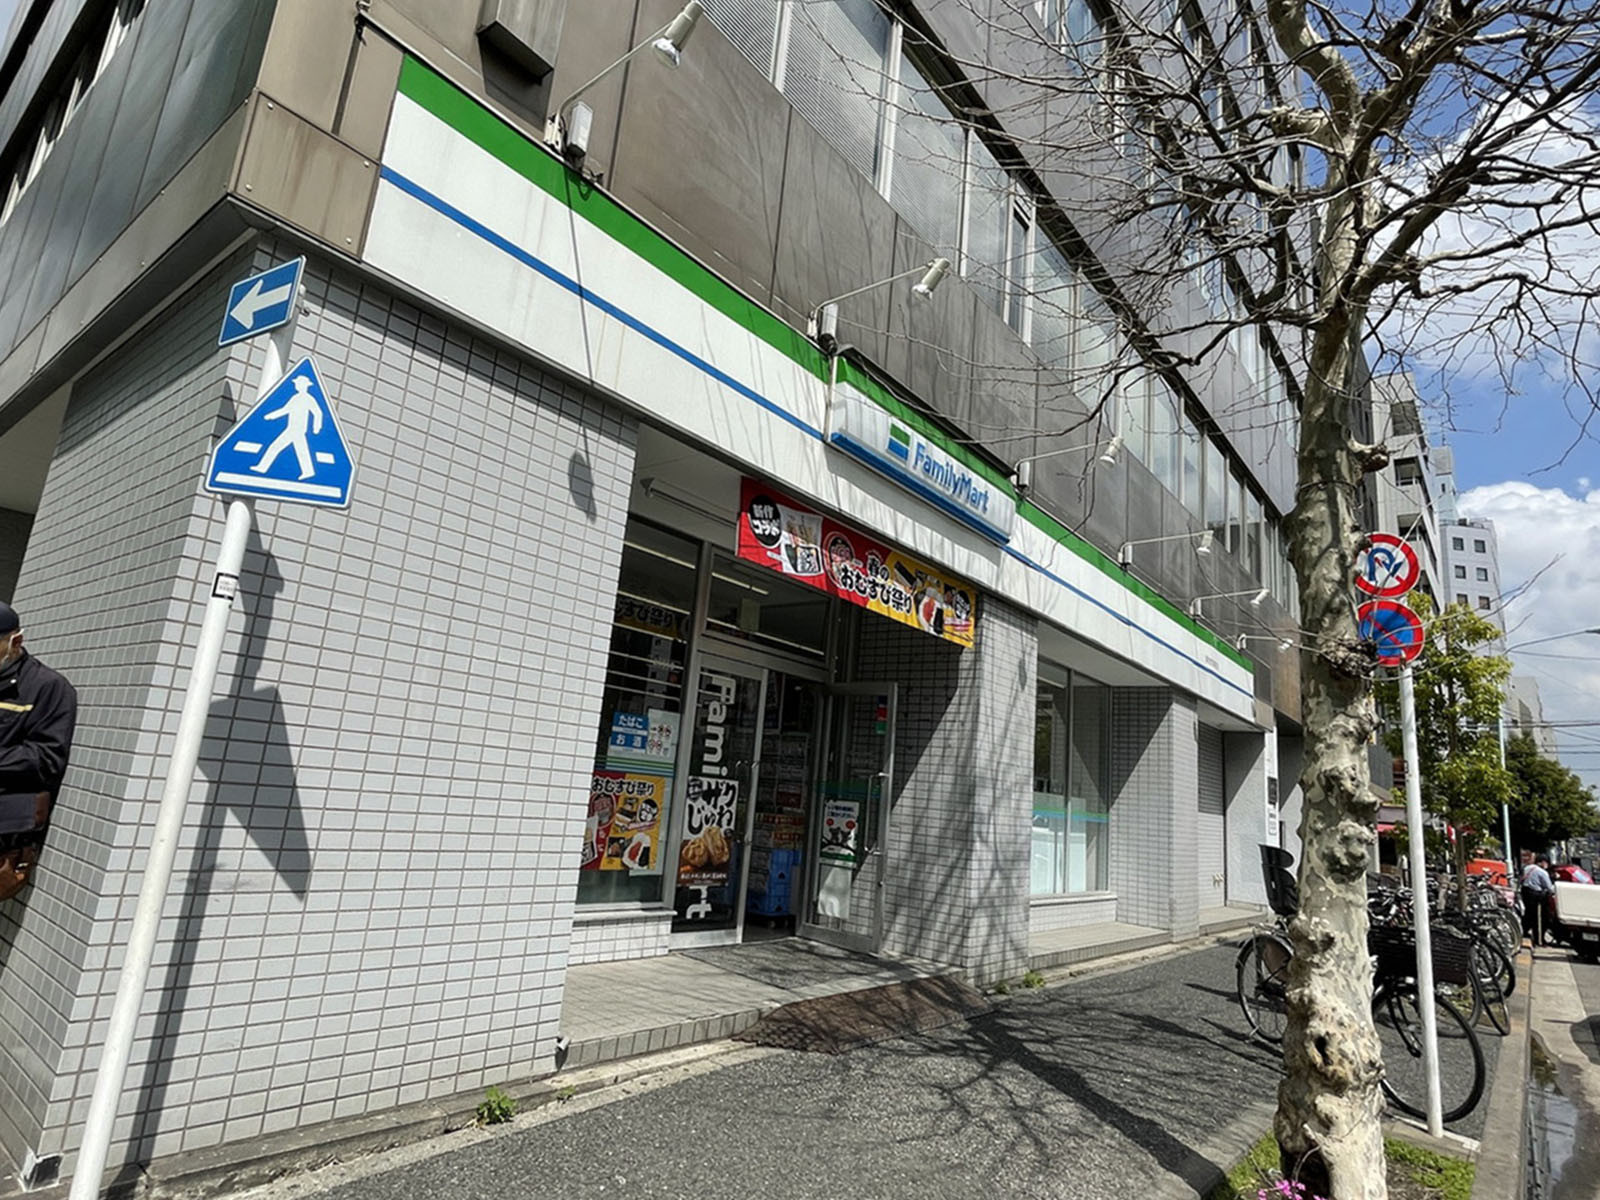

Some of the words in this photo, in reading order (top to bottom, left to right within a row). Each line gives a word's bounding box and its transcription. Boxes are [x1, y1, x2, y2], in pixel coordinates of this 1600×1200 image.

[912, 442, 989, 514] FamilyMart
[868, 556, 889, 581] 春の
[841, 565, 912, 613] おむすび祭り
[618, 714, 644, 729] たばこ
[592, 778, 654, 796] おむすび祭り
